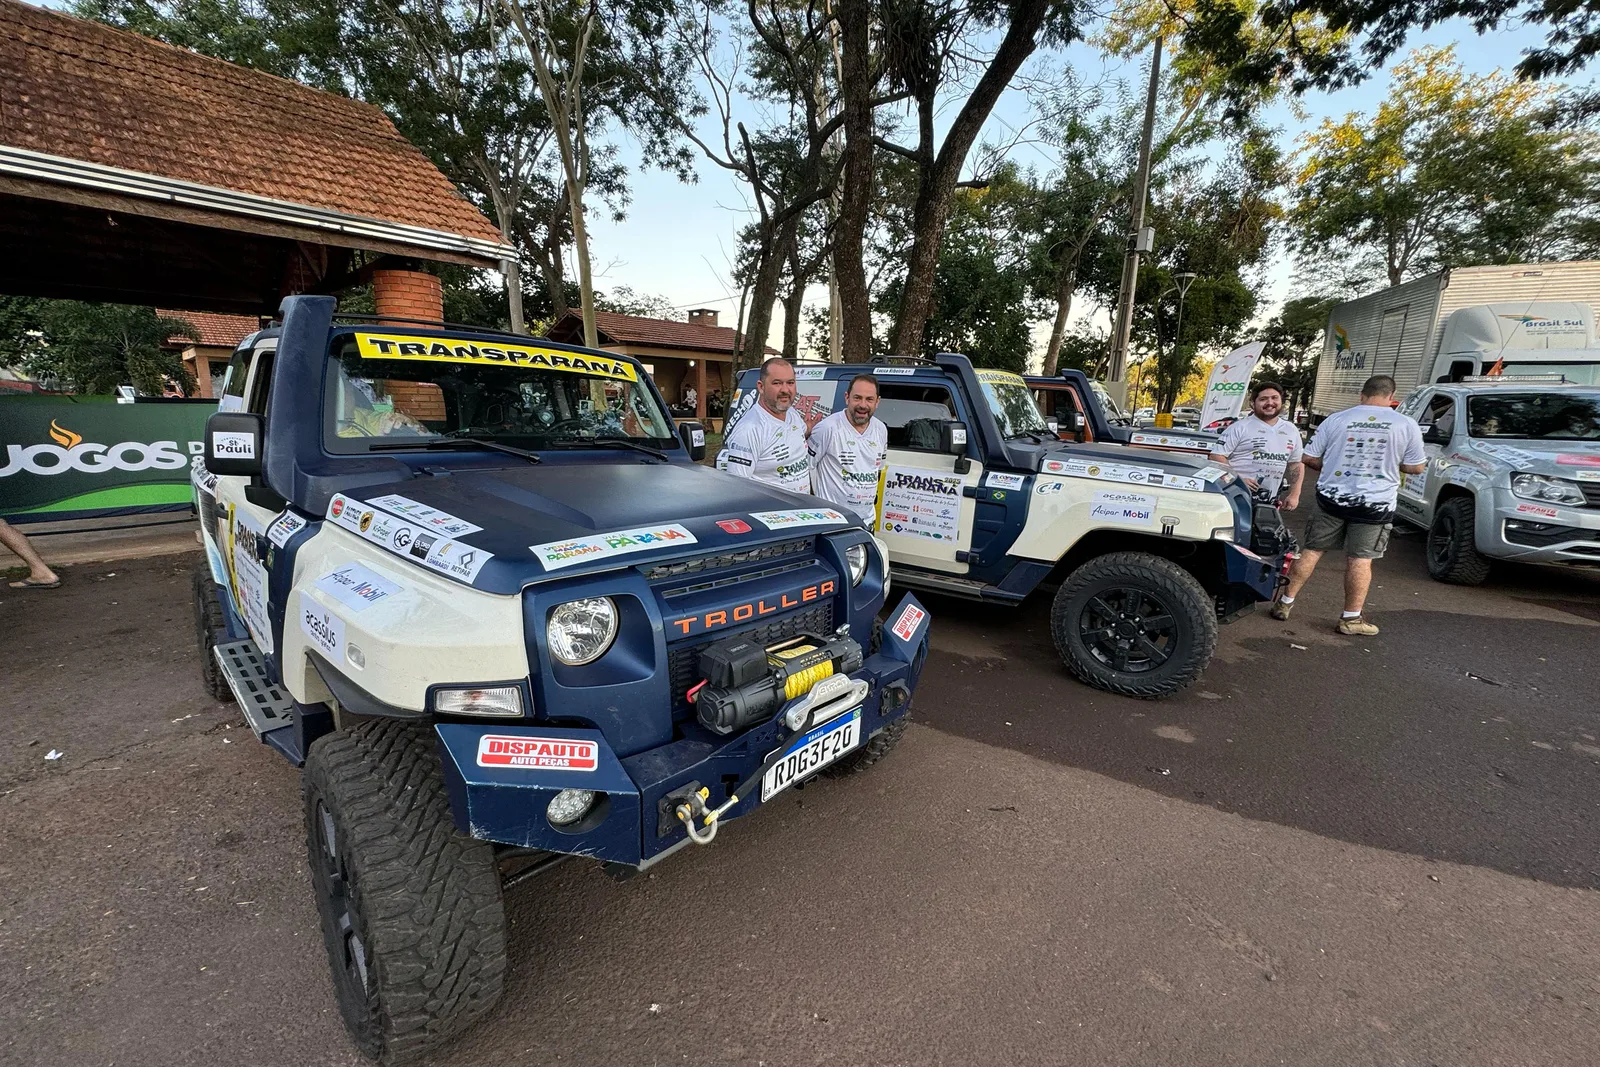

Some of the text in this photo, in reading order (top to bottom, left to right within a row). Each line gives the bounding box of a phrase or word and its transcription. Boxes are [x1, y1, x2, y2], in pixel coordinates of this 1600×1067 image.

[1526, 319, 1561, 327] Brasil
[367, 338, 631, 378] TRANSPARANÁ
[1211, 382, 1245, 391] JOGOS
[216, 444, 252, 454] Pauli
[0, 441, 188, 477] JOGOS
[1122, 509, 1151, 519] Mobil
[451, 564, 472, 578] RETIPAR
[351, 581, 387, 602] Mobil
[674, 581, 834, 633] TROLLER
[306, 609, 336, 648] acassius
[896, 607, 917, 634] DISPAUTO
[489, 741, 591, 757] DISPAUTO
[774, 724, 853, 790] RDG3F20
[509, 756, 570, 767] AUTO PEÇAS
